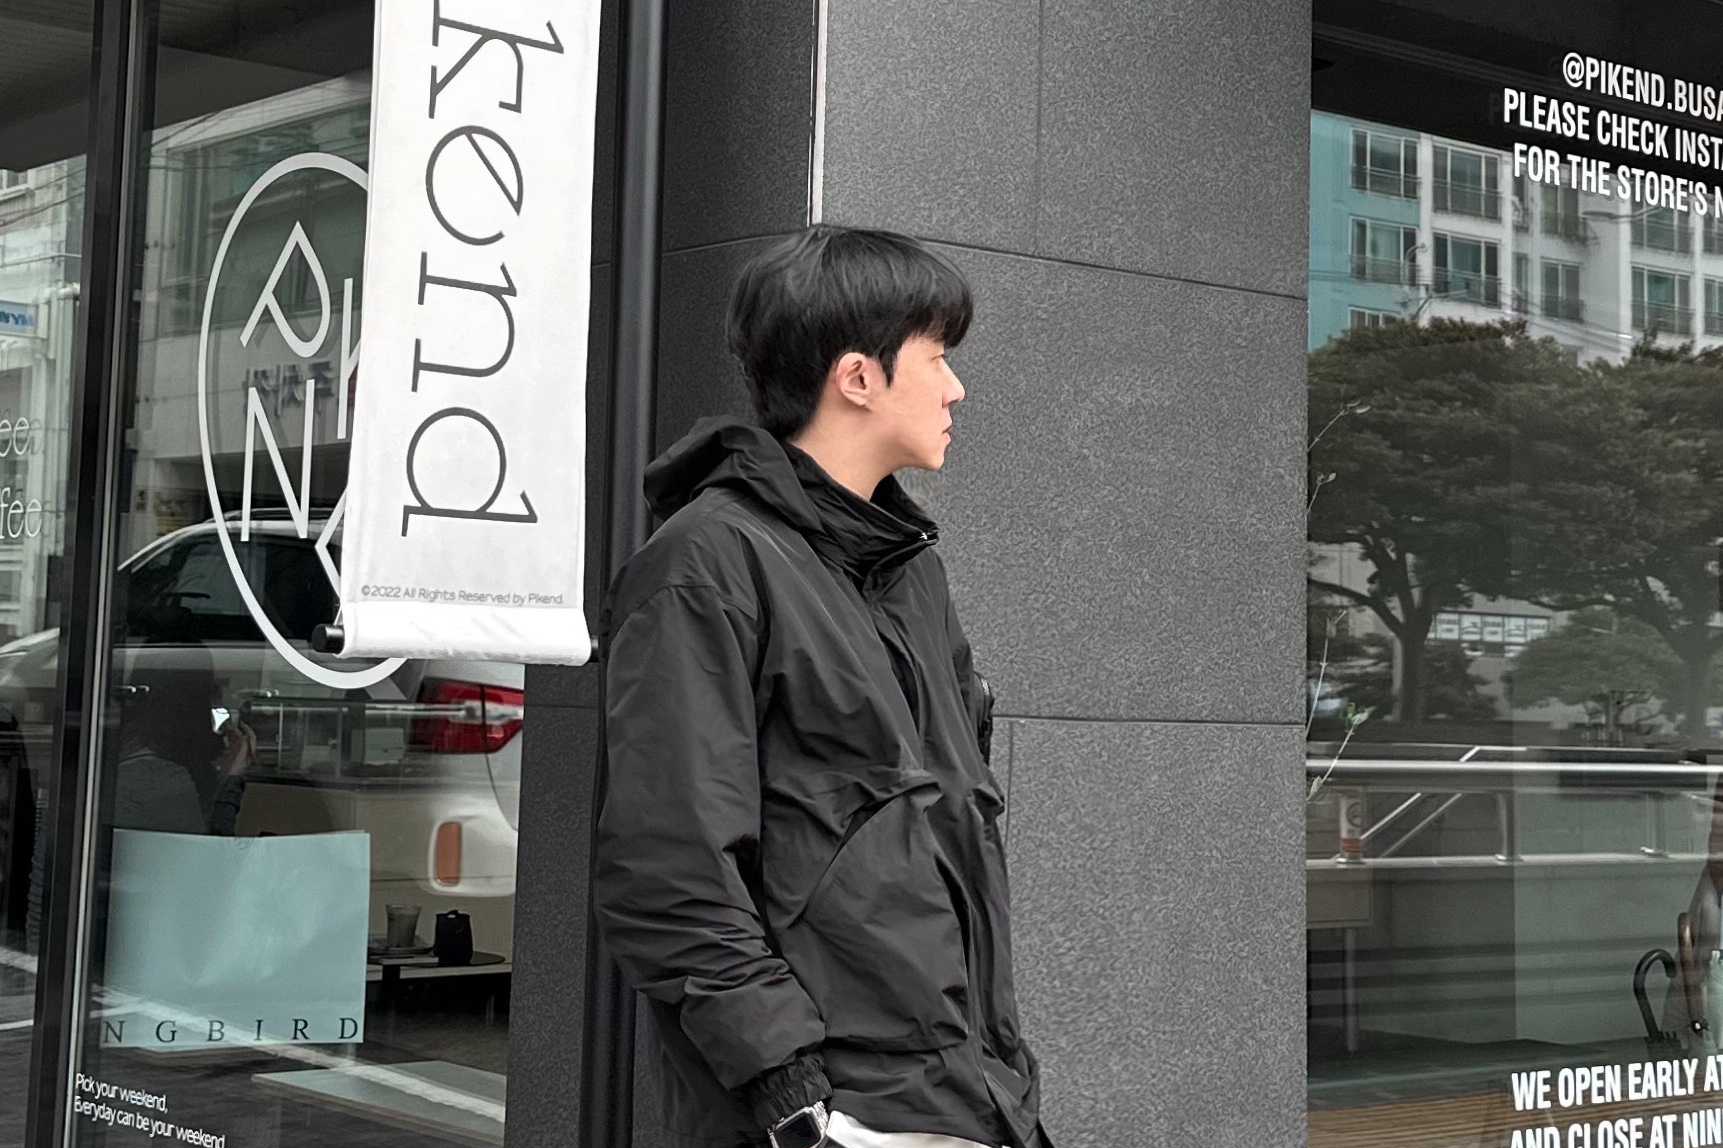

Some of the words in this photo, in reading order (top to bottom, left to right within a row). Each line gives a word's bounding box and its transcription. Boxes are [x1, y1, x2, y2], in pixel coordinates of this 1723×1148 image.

[1503, 87, 1591, 141] PLEASE
[1596, 110, 1669, 158] CHECK
[1674, 128, 1723, 171] INST
[1513, 142, 1561, 186] FOR
[1566, 153, 1611, 197] THE
[1616, 165, 1708, 217] STORE'S
[403, 587, 416, 598] All
[418, 588, 456, 603] Rights
[458, 590, 511, 604] Reserved
[512, 593, 526, 607] by
[75, 1072, 96, 1093] Pick
[94, 1081, 119, 1100] your
[119, 1088, 169, 1114] weekend,
[1511, 1070, 1552, 1111] WE
[1557, 1064, 1622, 1108] OPEN
[1628, 1058, 1699, 1100] EARLY
[74, 1095, 116, 1126] Everyday
[116, 1109, 135, 1128] can
[136, 1111, 150, 1131] be
[149, 1118, 176, 1138] your
